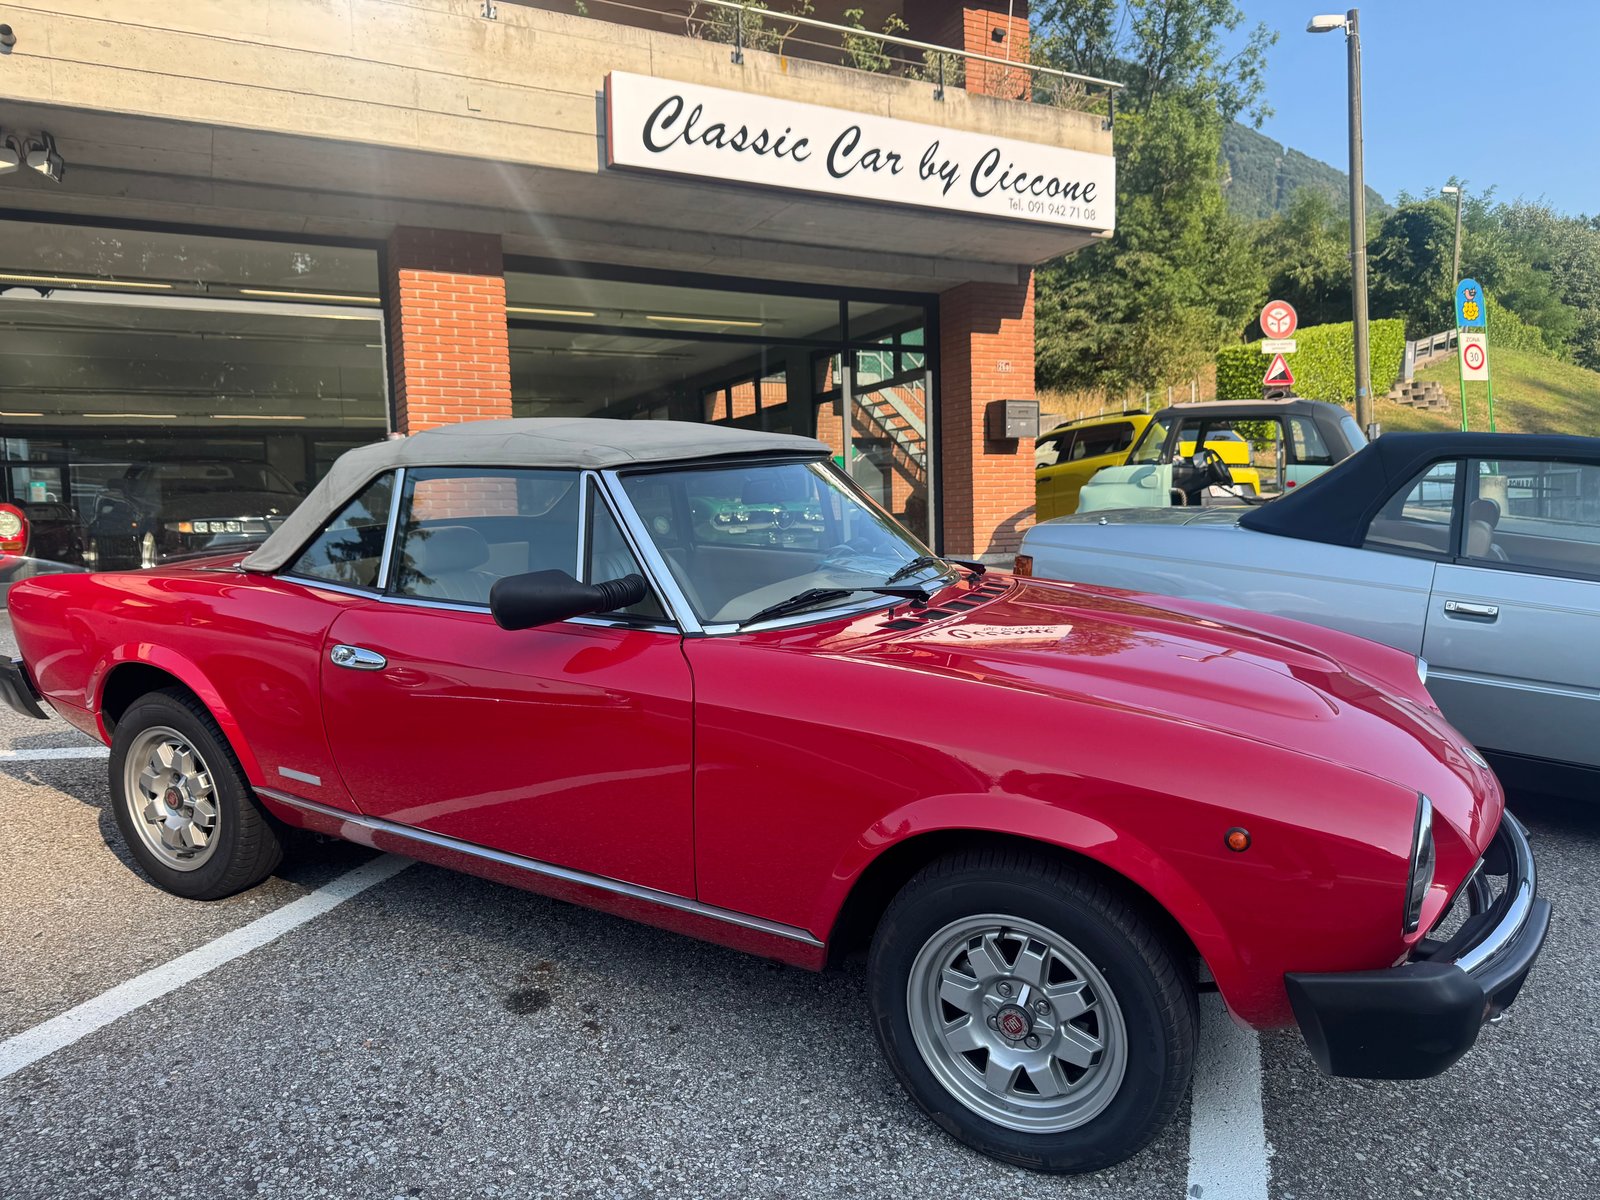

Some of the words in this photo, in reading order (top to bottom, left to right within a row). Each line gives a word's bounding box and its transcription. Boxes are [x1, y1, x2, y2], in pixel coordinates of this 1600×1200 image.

[642, 94, 812, 163] Classic
[826, 125, 904, 178] Car
[919, 140, 961, 197] by
[970, 147, 1098, 203] Ciccone
[1008, 198, 1024, 211] Tel.
[1028, 200, 1044, 214] 091
[1048, 204, 1066, 217] 942
[1069, 206, 1080, 219] 71
[1084, 208, 1096, 221] 08
[1470, 352, 1480, 362] 30
[1004, 1016, 1021, 1033] FIAT
